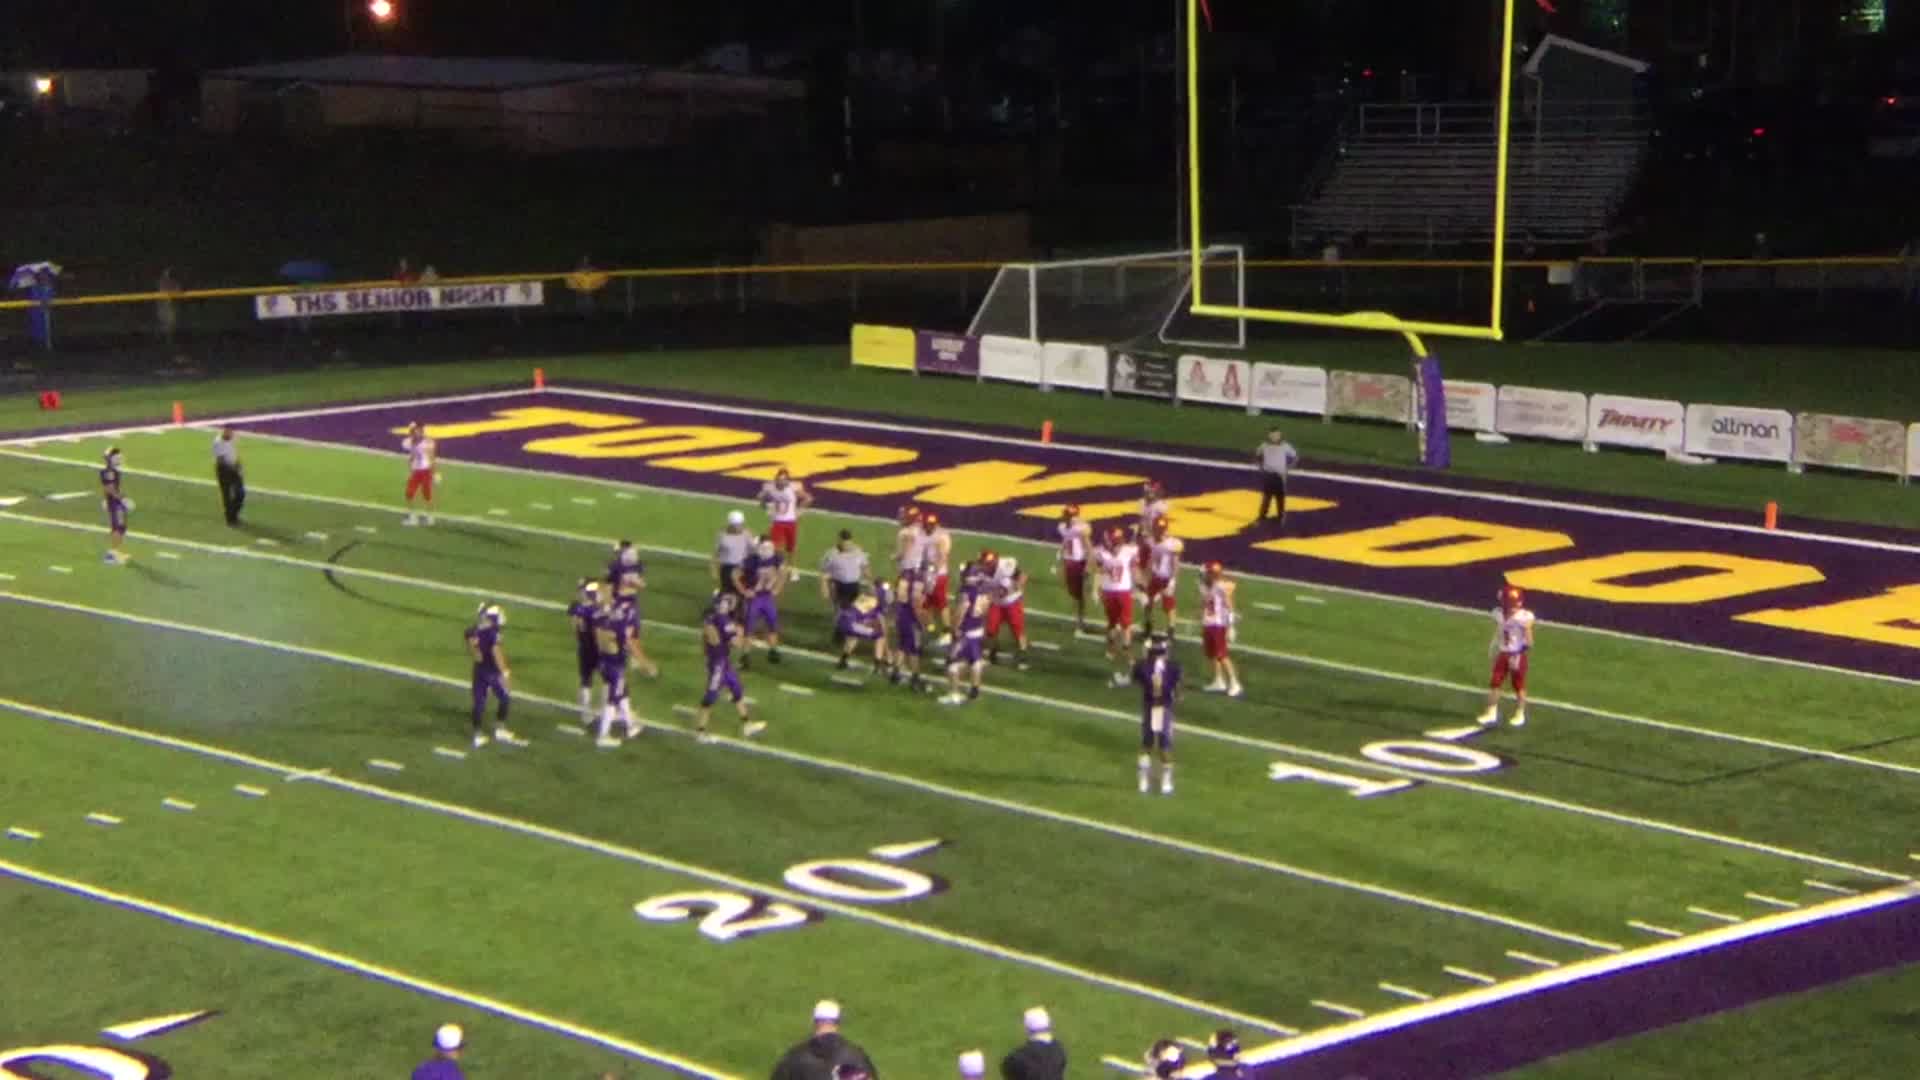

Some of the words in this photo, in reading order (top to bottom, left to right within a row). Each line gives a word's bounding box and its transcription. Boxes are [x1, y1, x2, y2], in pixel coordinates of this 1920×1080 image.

[294, 295, 338, 313] THS
[346, 289, 433, 310] SENIOR
[440, 286, 509, 304] NIGHT
[1712, 416, 1780, 439] altman
[1268, 739, 1501, 797] 10
[635, 858, 932, 940] 20
